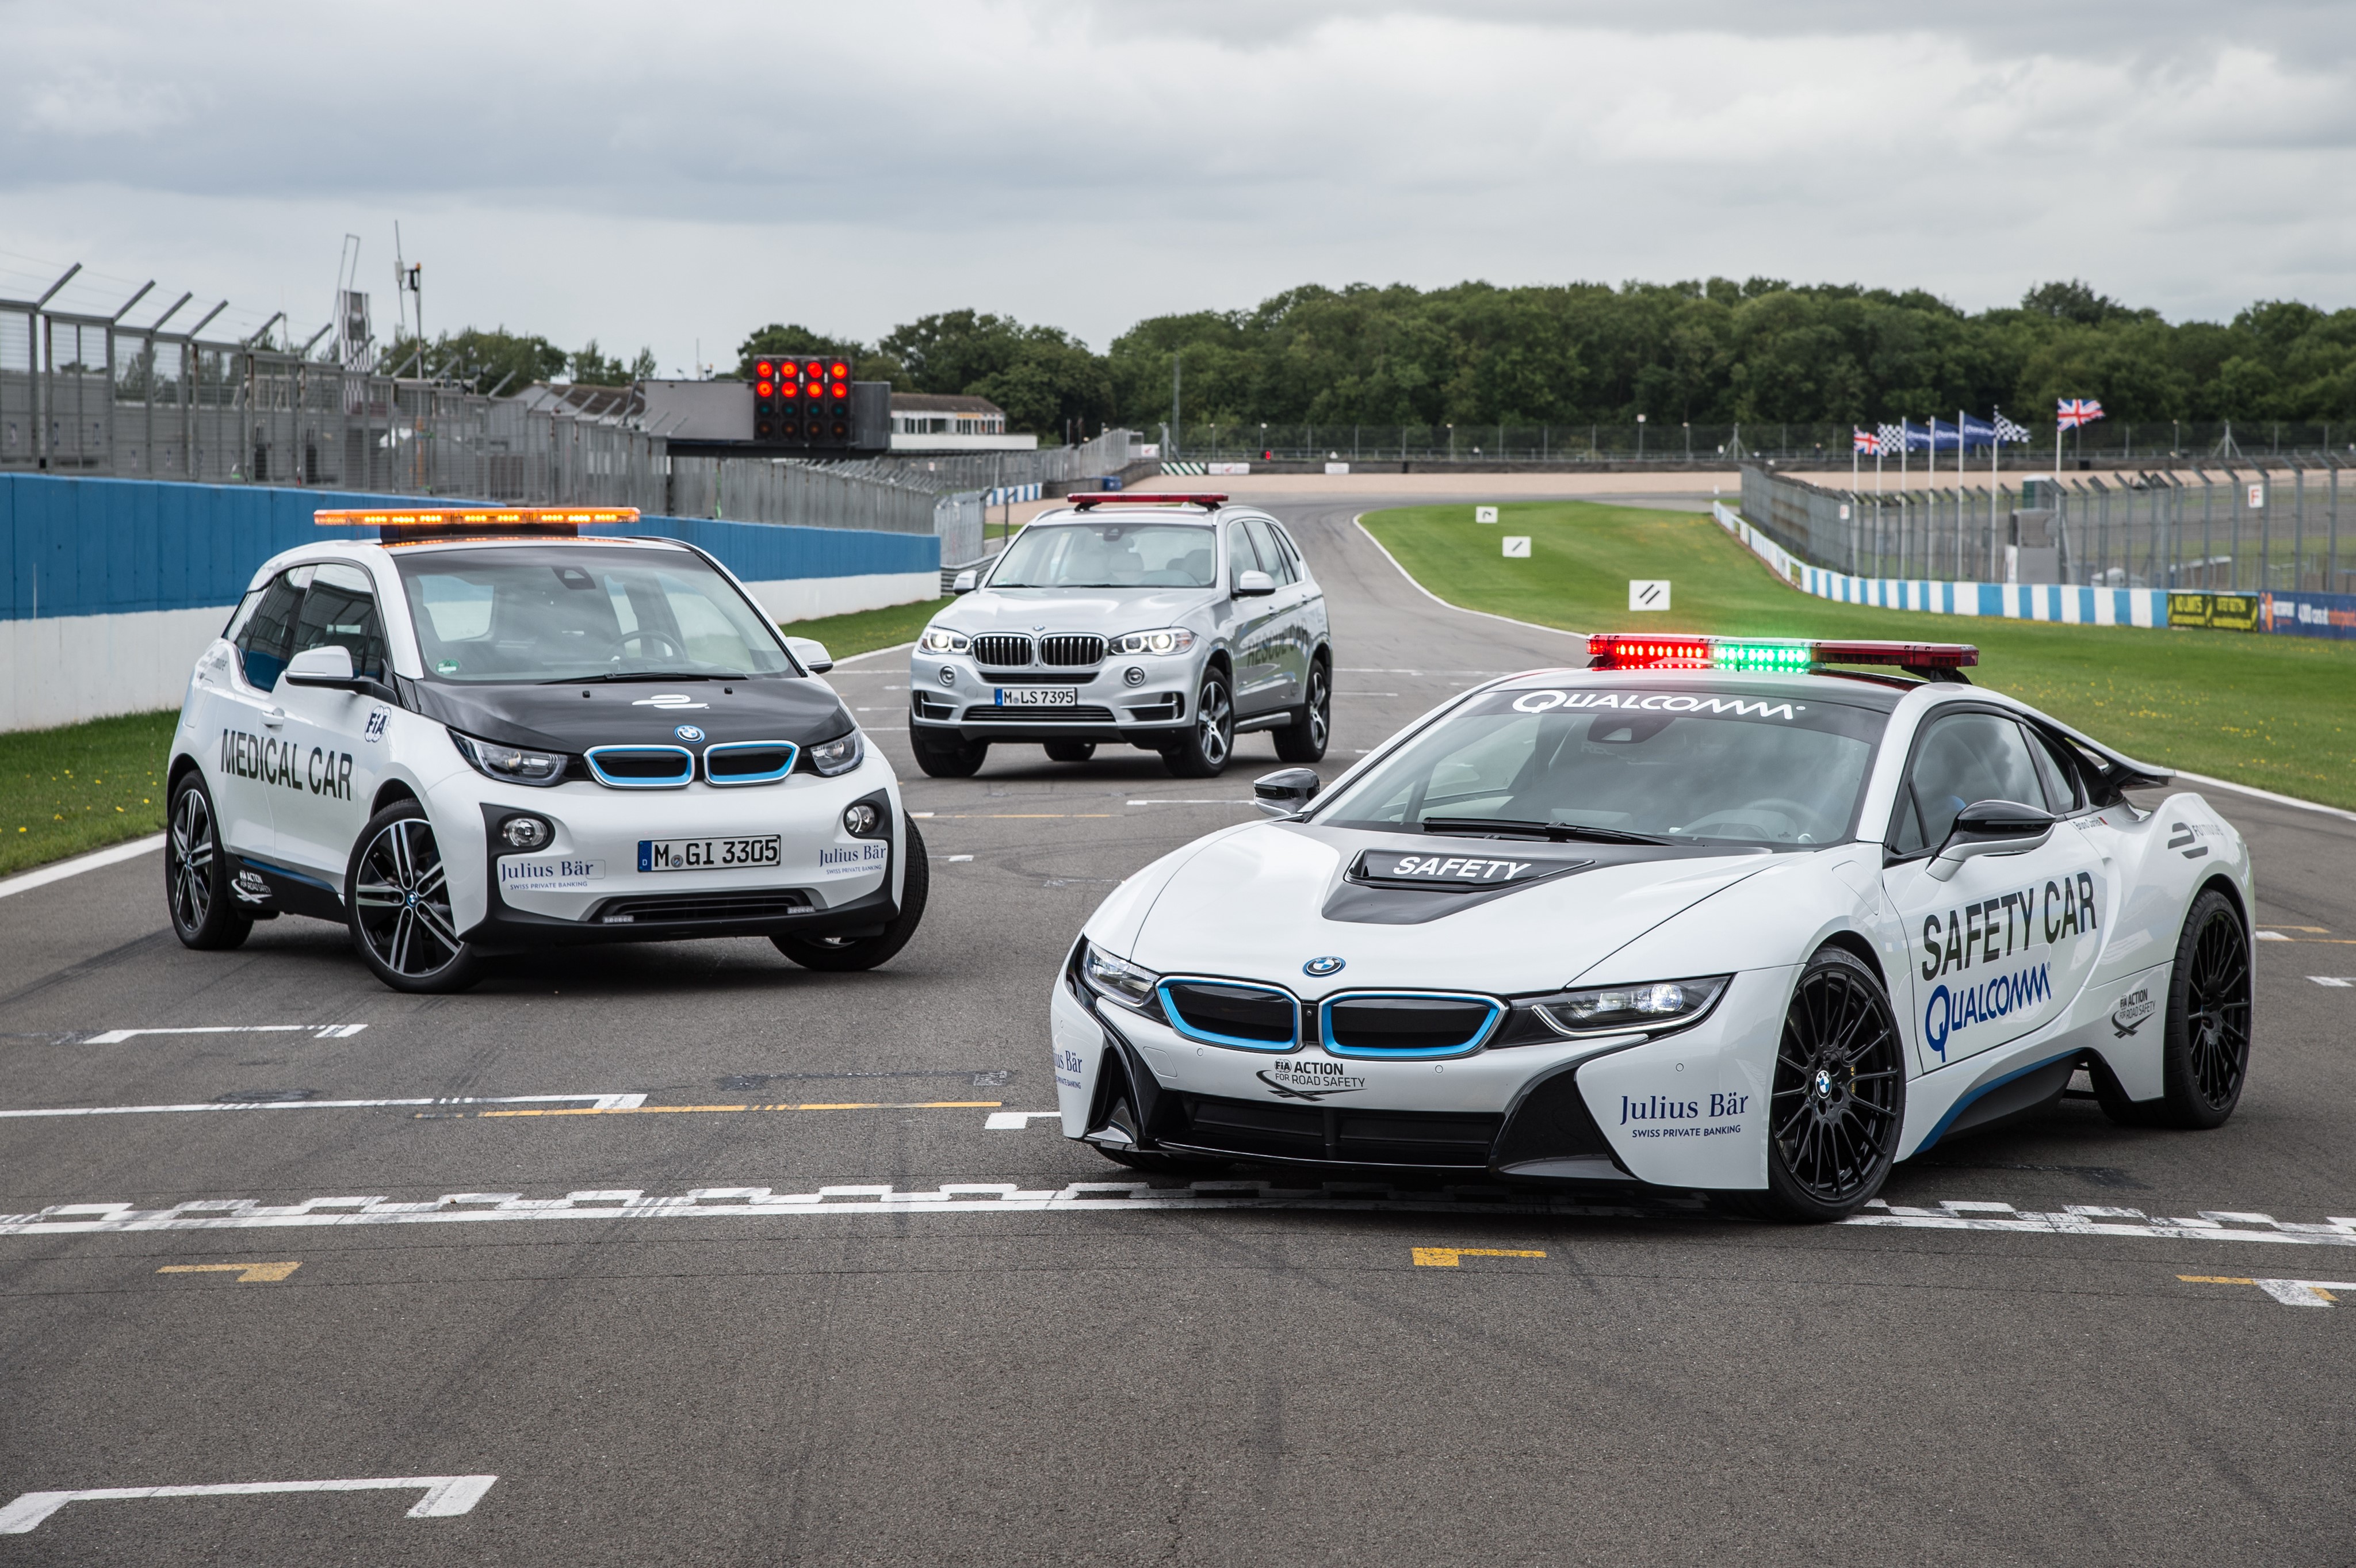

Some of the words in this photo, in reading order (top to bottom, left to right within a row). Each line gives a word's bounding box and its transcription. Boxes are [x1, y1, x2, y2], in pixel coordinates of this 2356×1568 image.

[2251, 489, 2259, 504] F
[1004, 691, 1012, 704] M
[1021, 691, 1038, 704] LS
[1041, 691, 1073, 704] 7395
[1512, 690, 1793, 720] QUALCOMM
[220, 728, 303, 791] MEDICAL
[308, 747, 353, 801] CAR
[654, 844, 669, 867] M
[686, 842, 715, 866] GI
[722, 839, 778, 864] 3305
[819, 848, 859, 867] Julius
[863, 844, 886, 861] Bär
[502, 862, 554, 882] Julius
[560, 861, 594, 877] Bär
[1393, 856, 1532, 881] SAFETY
[1922, 888, 2034, 981] SAFETY
[2044, 871, 2097, 944] CAR
[2128, 988, 2148, 1007] ACTION
[1925, 962, 2052, 1064] QUALCOMM
[2126, 1006, 2139, 1020] ROAD
[2139, 1000, 2156, 1015] SAFETY
[1065, 1050, 1082, 1073] Bär
[1294, 1061, 1344, 1075] ACTION
[1275, 1073, 1290, 1081] FOR
[1292, 1074, 1320, 1086] ROAD
[1324, 1076, 1366, 1088] SAFETY
[1620, 1095, 1699, 1126] Julius
[1708, 1091, 1749, 1118] Bär
[1632, 1129, 1661, 1138] SWISS
[1663, 1127, 1701, 1137] PRIVATE
[1704, 1125, 1741, 1137] BANKING
